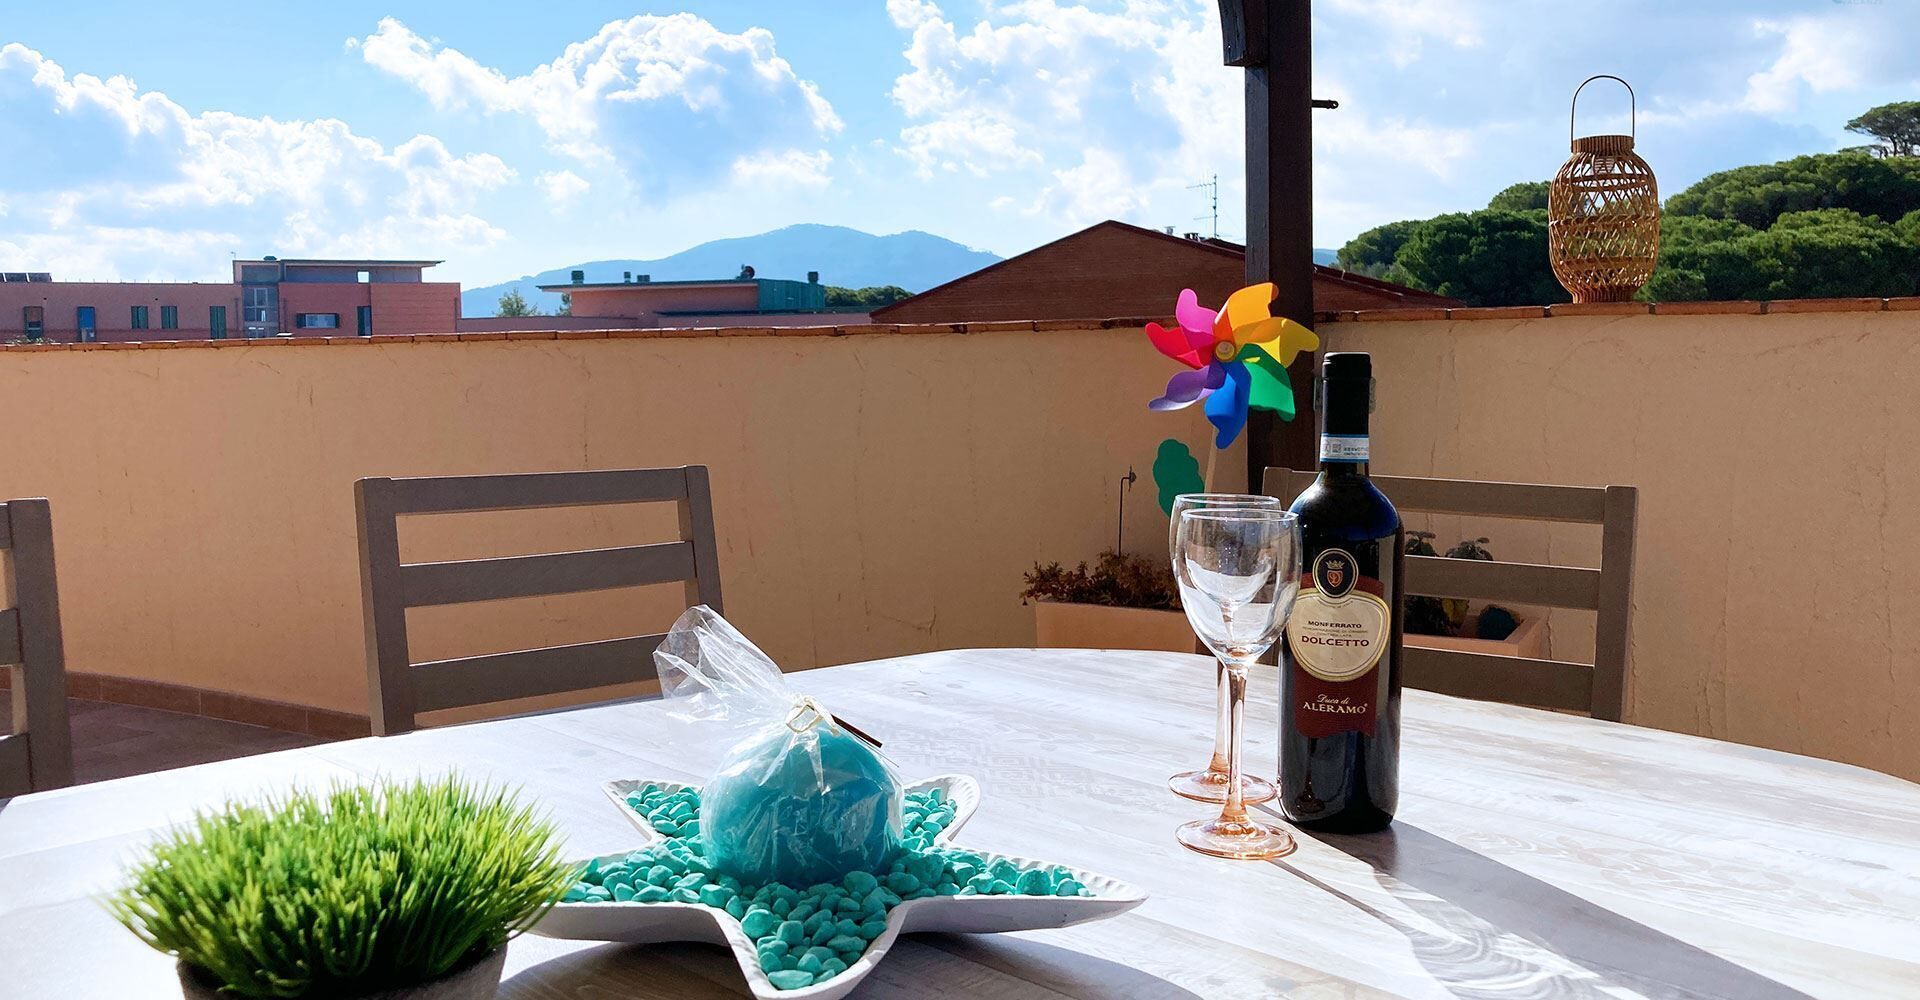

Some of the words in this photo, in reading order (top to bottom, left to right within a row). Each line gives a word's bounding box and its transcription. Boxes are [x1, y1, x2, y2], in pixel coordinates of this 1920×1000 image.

[1308, 620, 1362, 629] MONFERRATO
[1301, 635, 1370, 647] DOLCETTO
[1303, 701, 1366, 714] ALERAMO
